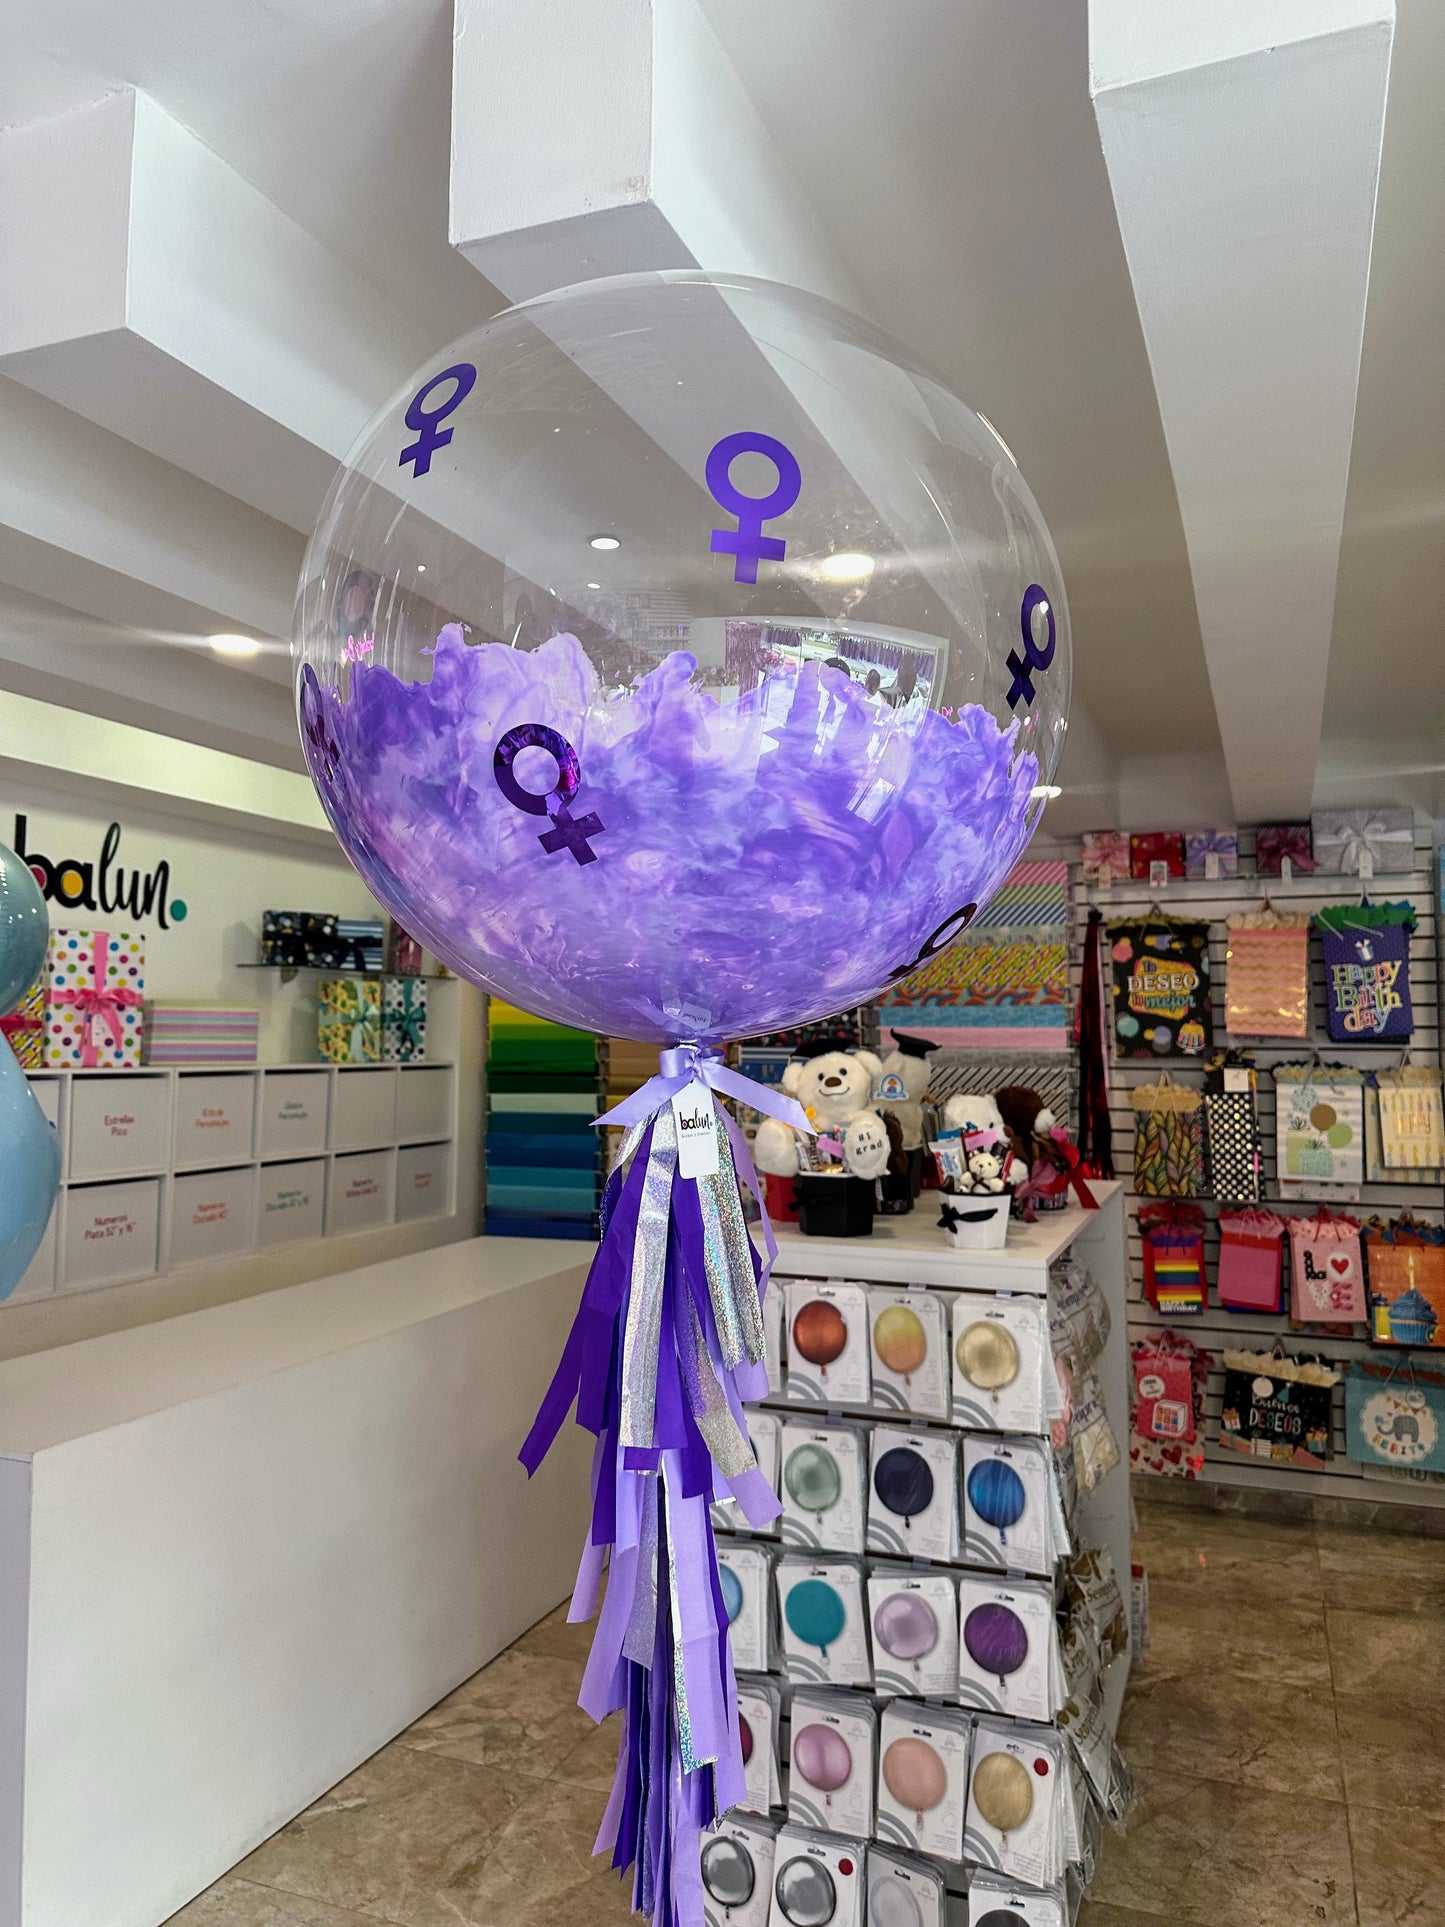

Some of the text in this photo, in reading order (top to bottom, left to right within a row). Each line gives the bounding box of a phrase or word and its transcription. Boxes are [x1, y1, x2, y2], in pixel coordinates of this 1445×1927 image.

[1127, 972, 1200, 993] DESEO
[1331, 960, 1402, 987] Happy
[1144, 991, 1197, 1012] mejor
[1333, 984, 1402, 1012] Birth
[1343, 1007, 1391, 1034] day
[855, 1139, 883, 1156] grad
